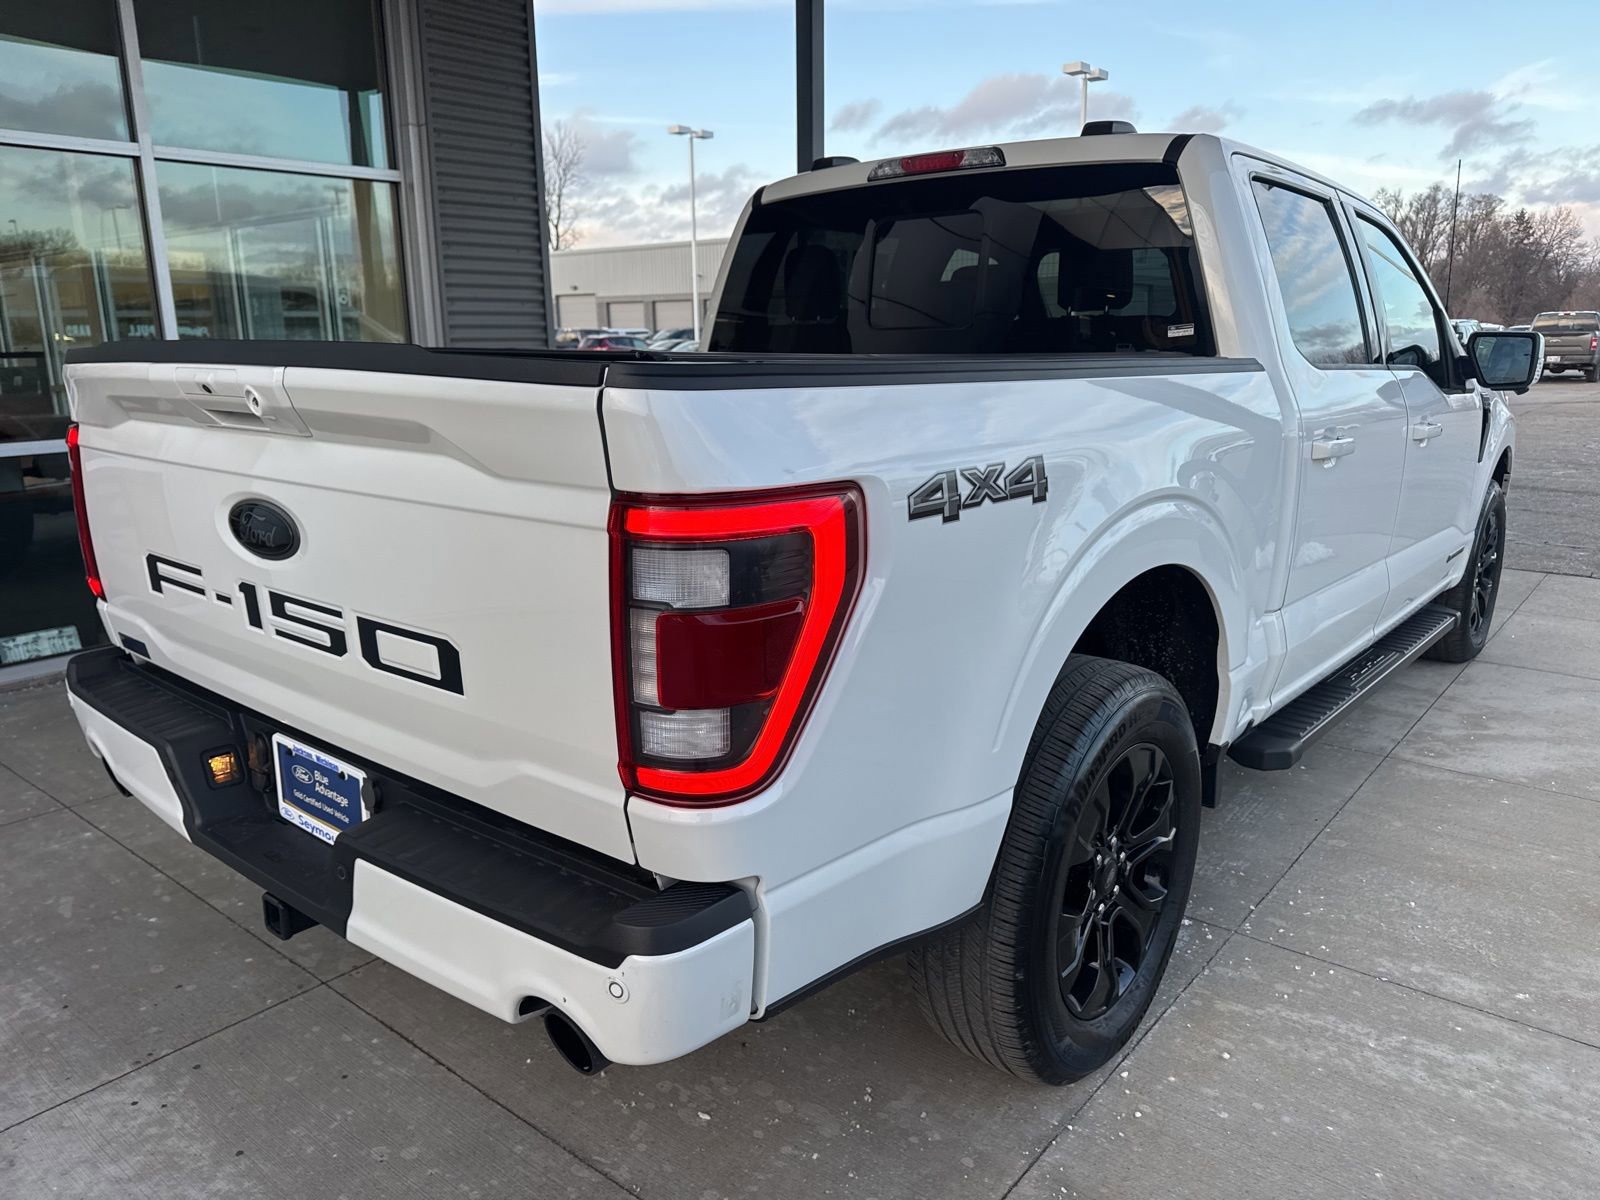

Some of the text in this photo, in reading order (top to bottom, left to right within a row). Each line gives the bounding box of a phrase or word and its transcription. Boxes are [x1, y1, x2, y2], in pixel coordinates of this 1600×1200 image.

[239, 510, 278, 548] Ford
[146, 553, 464, 696] F-150
[314, 770, 329, 785] Blue
[314, 783, 349, 807] Advantage
